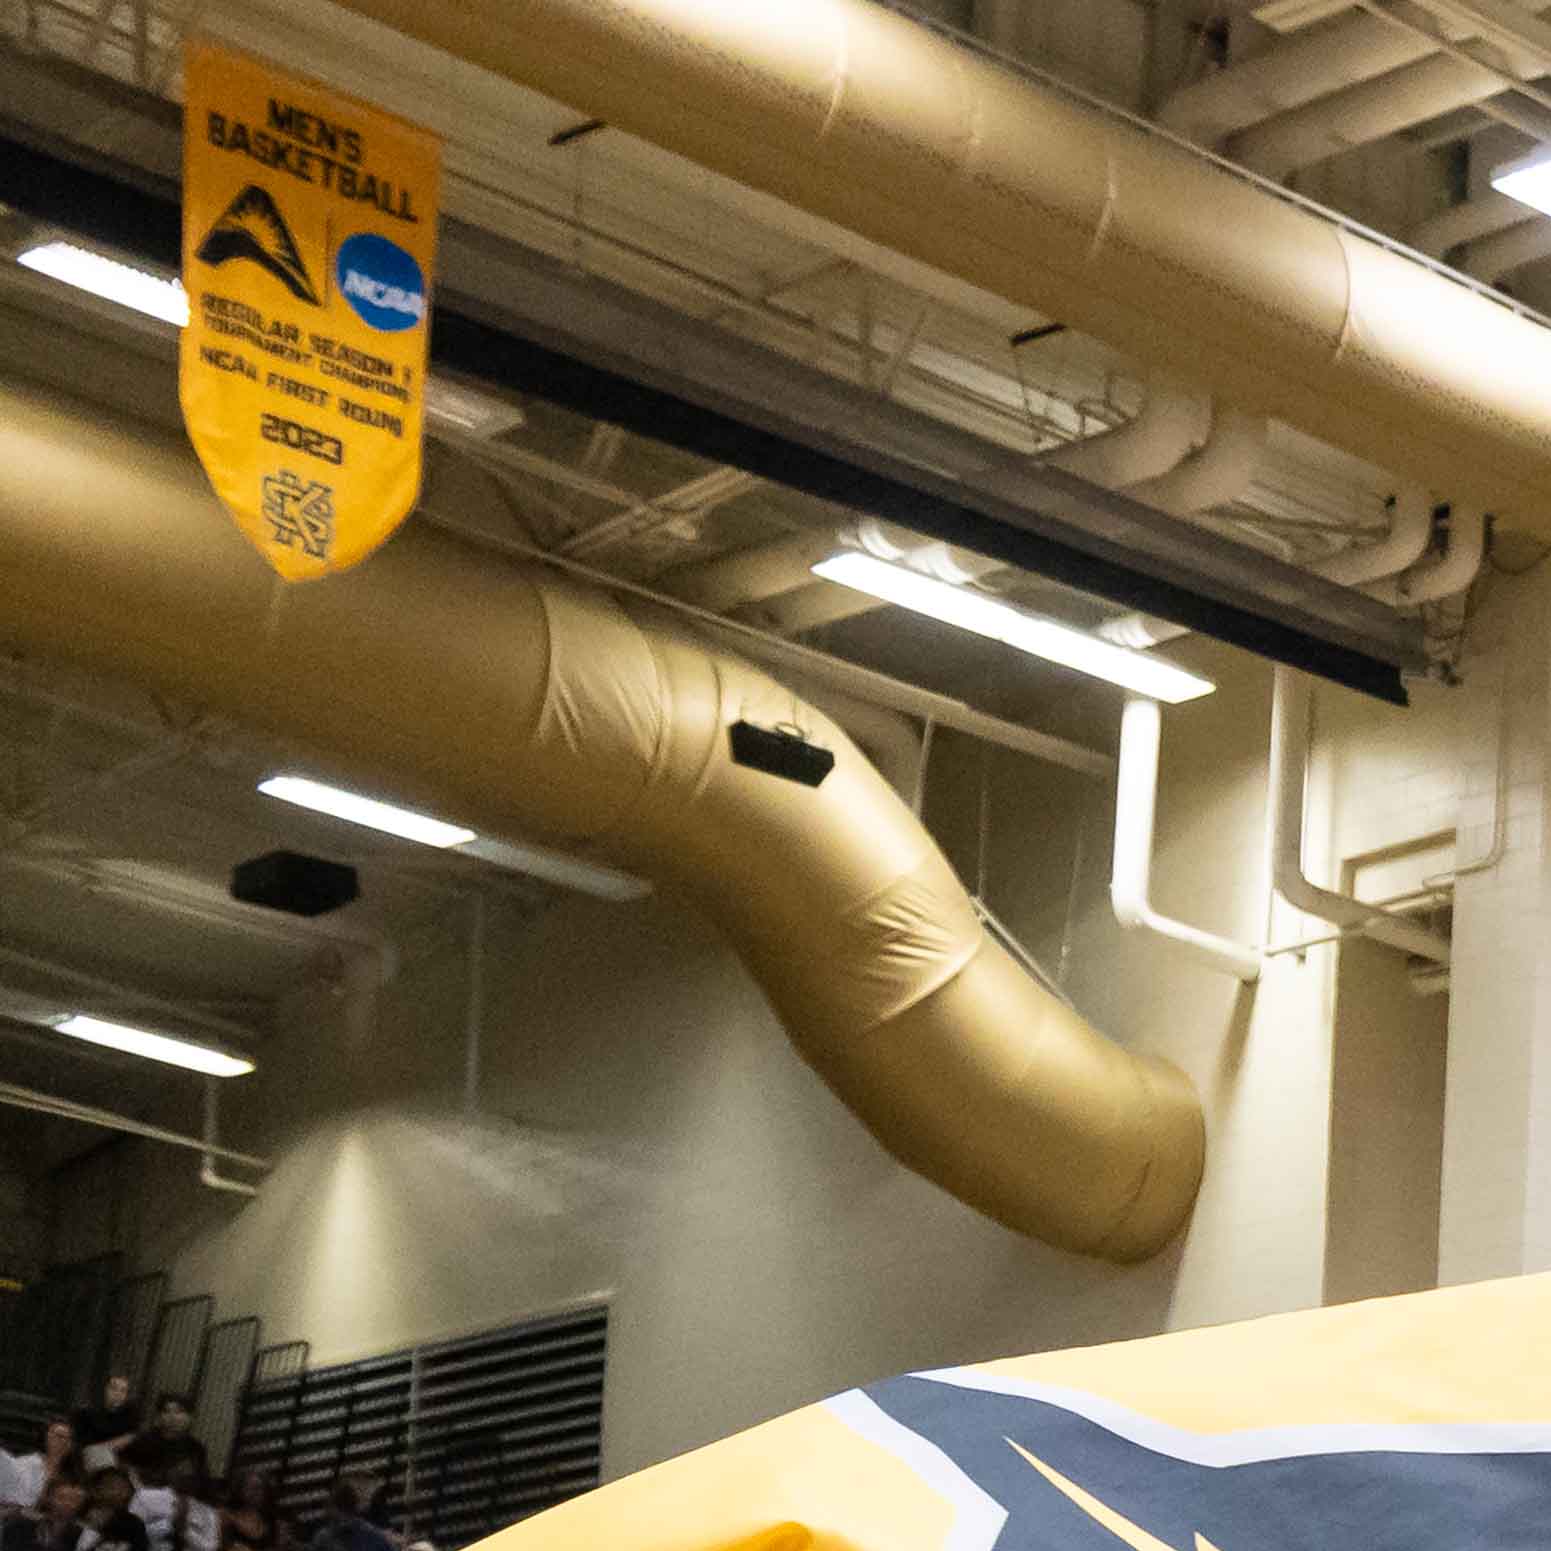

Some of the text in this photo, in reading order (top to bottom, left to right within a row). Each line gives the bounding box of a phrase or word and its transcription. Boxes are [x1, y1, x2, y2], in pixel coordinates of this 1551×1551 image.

[207, 111, 419, 224] BASKETBALL
[309, 333, 394, 377] SEASON
[266, 371, 330, 408] FIRST
[338, 398, 404, 438] ROUND
[261, 411, 343, 465] 2023
